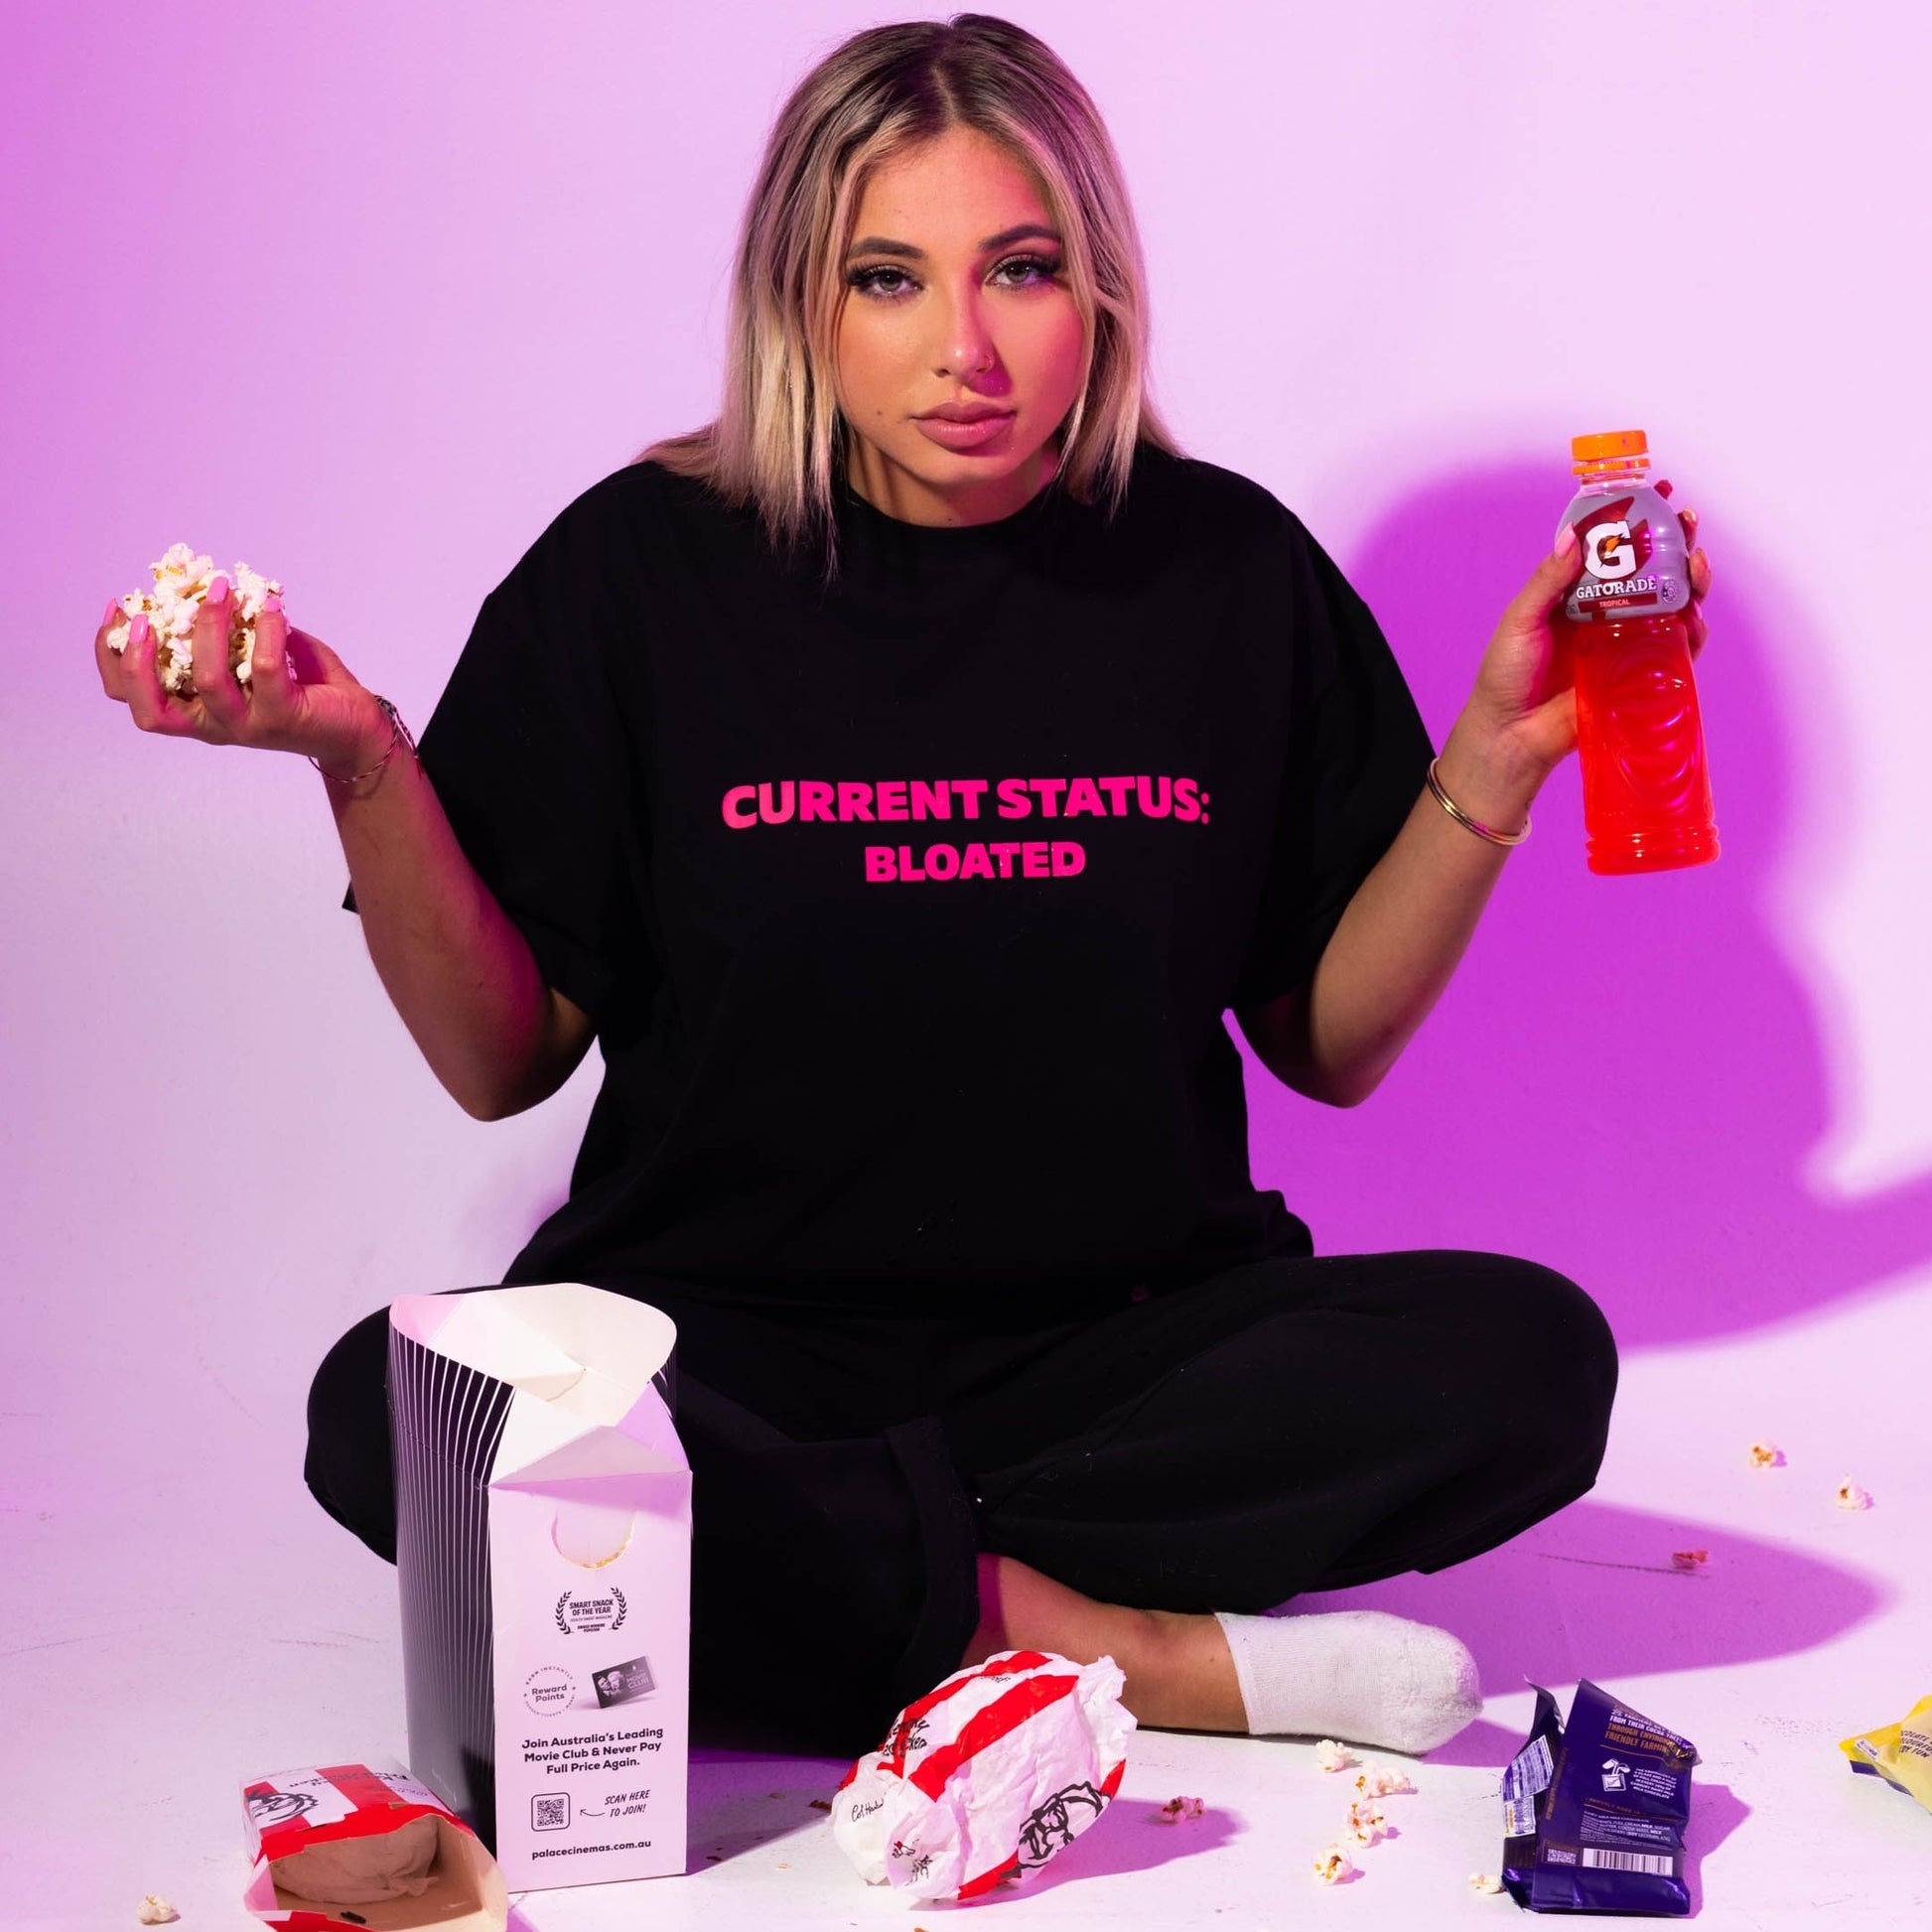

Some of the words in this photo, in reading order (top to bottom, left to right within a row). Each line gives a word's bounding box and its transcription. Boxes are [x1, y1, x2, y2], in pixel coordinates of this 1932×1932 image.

[1584, 520, 1637, 580] G
[1576, 578, 1657, 599] GATORADE
[1599, 599, 1630, 608] TROPICAL
[722, 780, 988, 829] CURRENT
[997, 776, 1209, 824] STATUS:
[865, 842, 1086, 882] BLOATED
[531, 1684, 567, 1695] Reward
[536, 1693, 565, 1703] Points
[521, 1739, 548, 1749] Join
[551, 1732, 615, 1746] Australia's
[618, 1728, 663, 1740] Leading
[524, 1751, 559, 1762] Movie
[562, 1748, 589, 1760] Club
[592, 1747, 600, 1756] &
[603, 1743, 637, 1755] Never
[639, 1741, 661, 1752] Pay
[547, 1764, 568, 1774] Full
[571, 1762, 600, 1772] Price
[603, 1757, 640, 1770] Again.
[605, 1793, 626, 1805] SCAN
[628, 1789, 650, 1802] HERE
[610, 1807, 621, 1818] TO
[622, 1803, 646, 1816] JOIN!
[532, 1840, 651, 1861] palacecinemas.com.au
